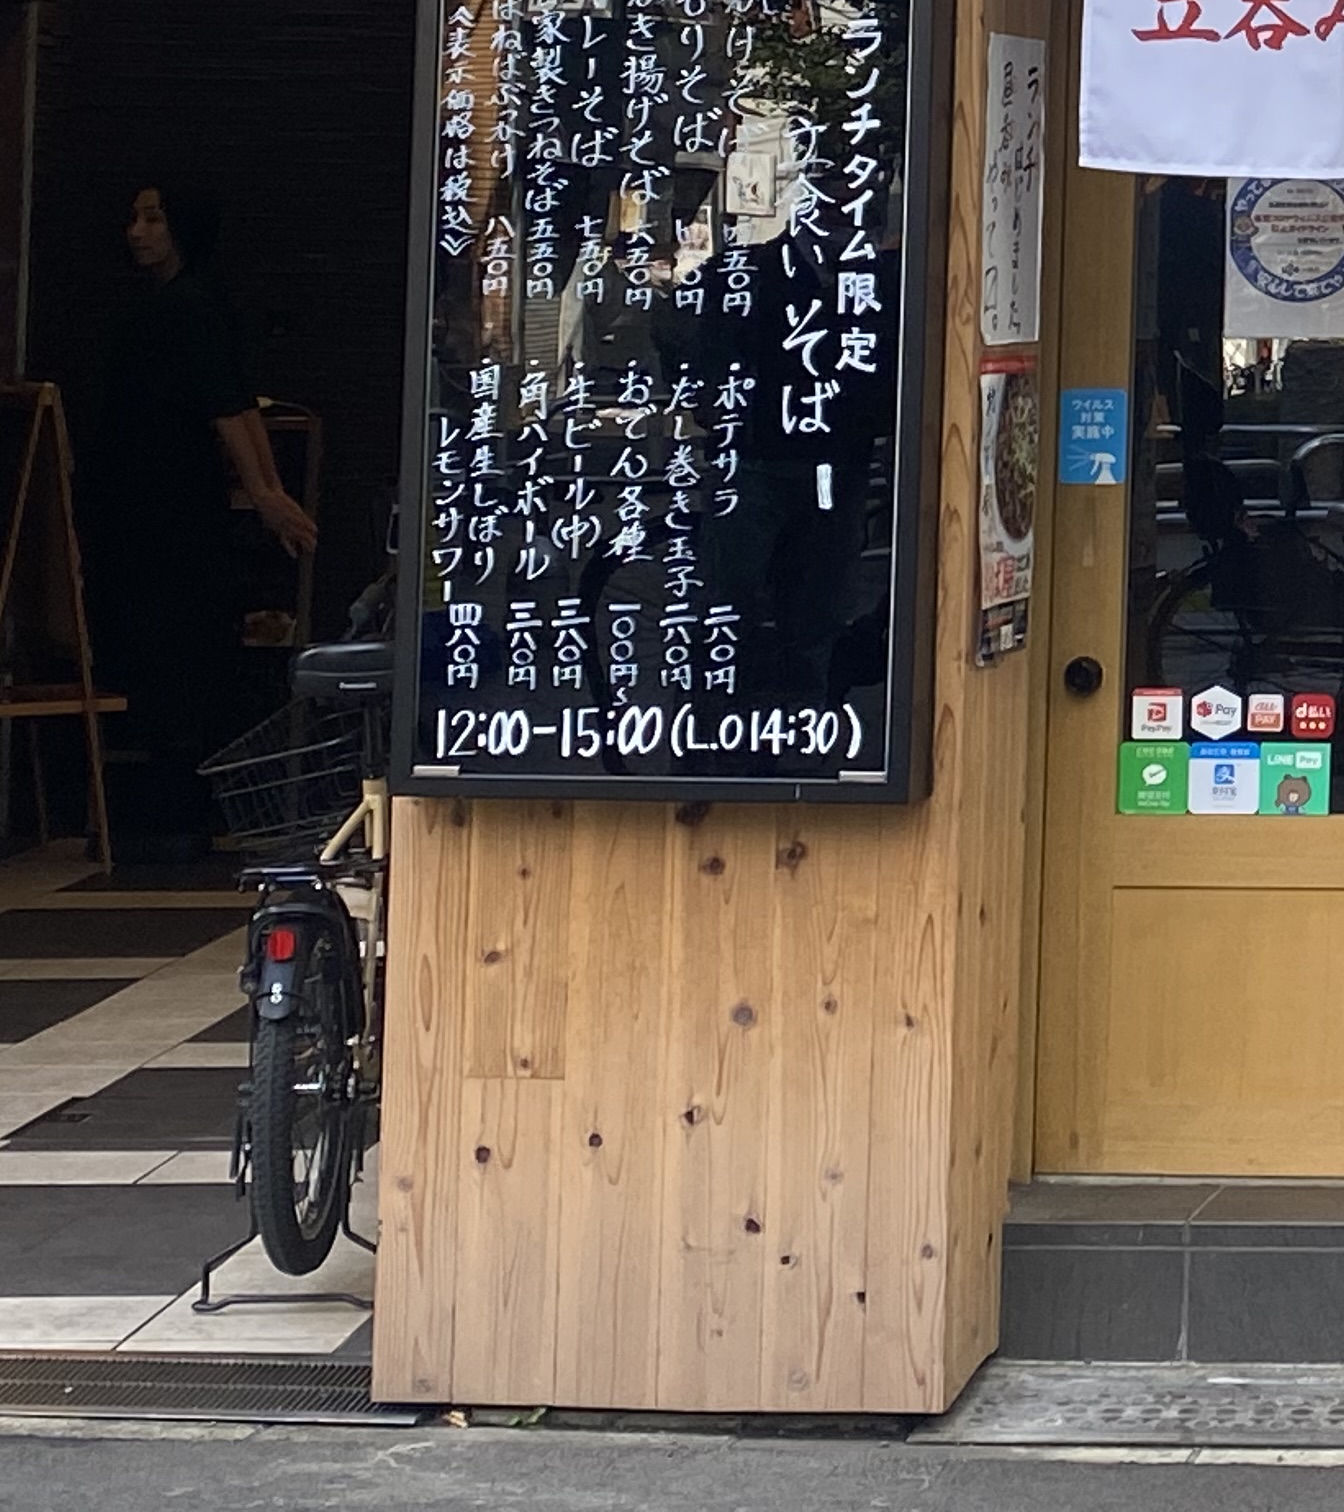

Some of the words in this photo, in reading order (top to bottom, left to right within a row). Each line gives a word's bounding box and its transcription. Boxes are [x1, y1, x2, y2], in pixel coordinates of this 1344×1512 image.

[526, 221, 559, 300] 五五〇円
[776, 115, 840, 433] 立食いそば
[838, 17, 883, 373] ランチタイム限定
[465, 363, 508, 585] 国産生しぼり
[515, 370, 554, 582] 角ハイボール
[603, 372, 656, 563] おでん各種
[662, 374, 704, 598] だし巻き玉子
[713, 376, 756, 518] ポテサラ
[1071, 399, 1114, 410] ウイルス
[431, 417, 466, 602] レモンサワー
[506, 600, 543, 691] 三八〇円
[551, 597, 590, 690] 三八〇円
[659, 602, 698, 691] 二八〇円
[704, 604, 741, 694] 二八〇円
